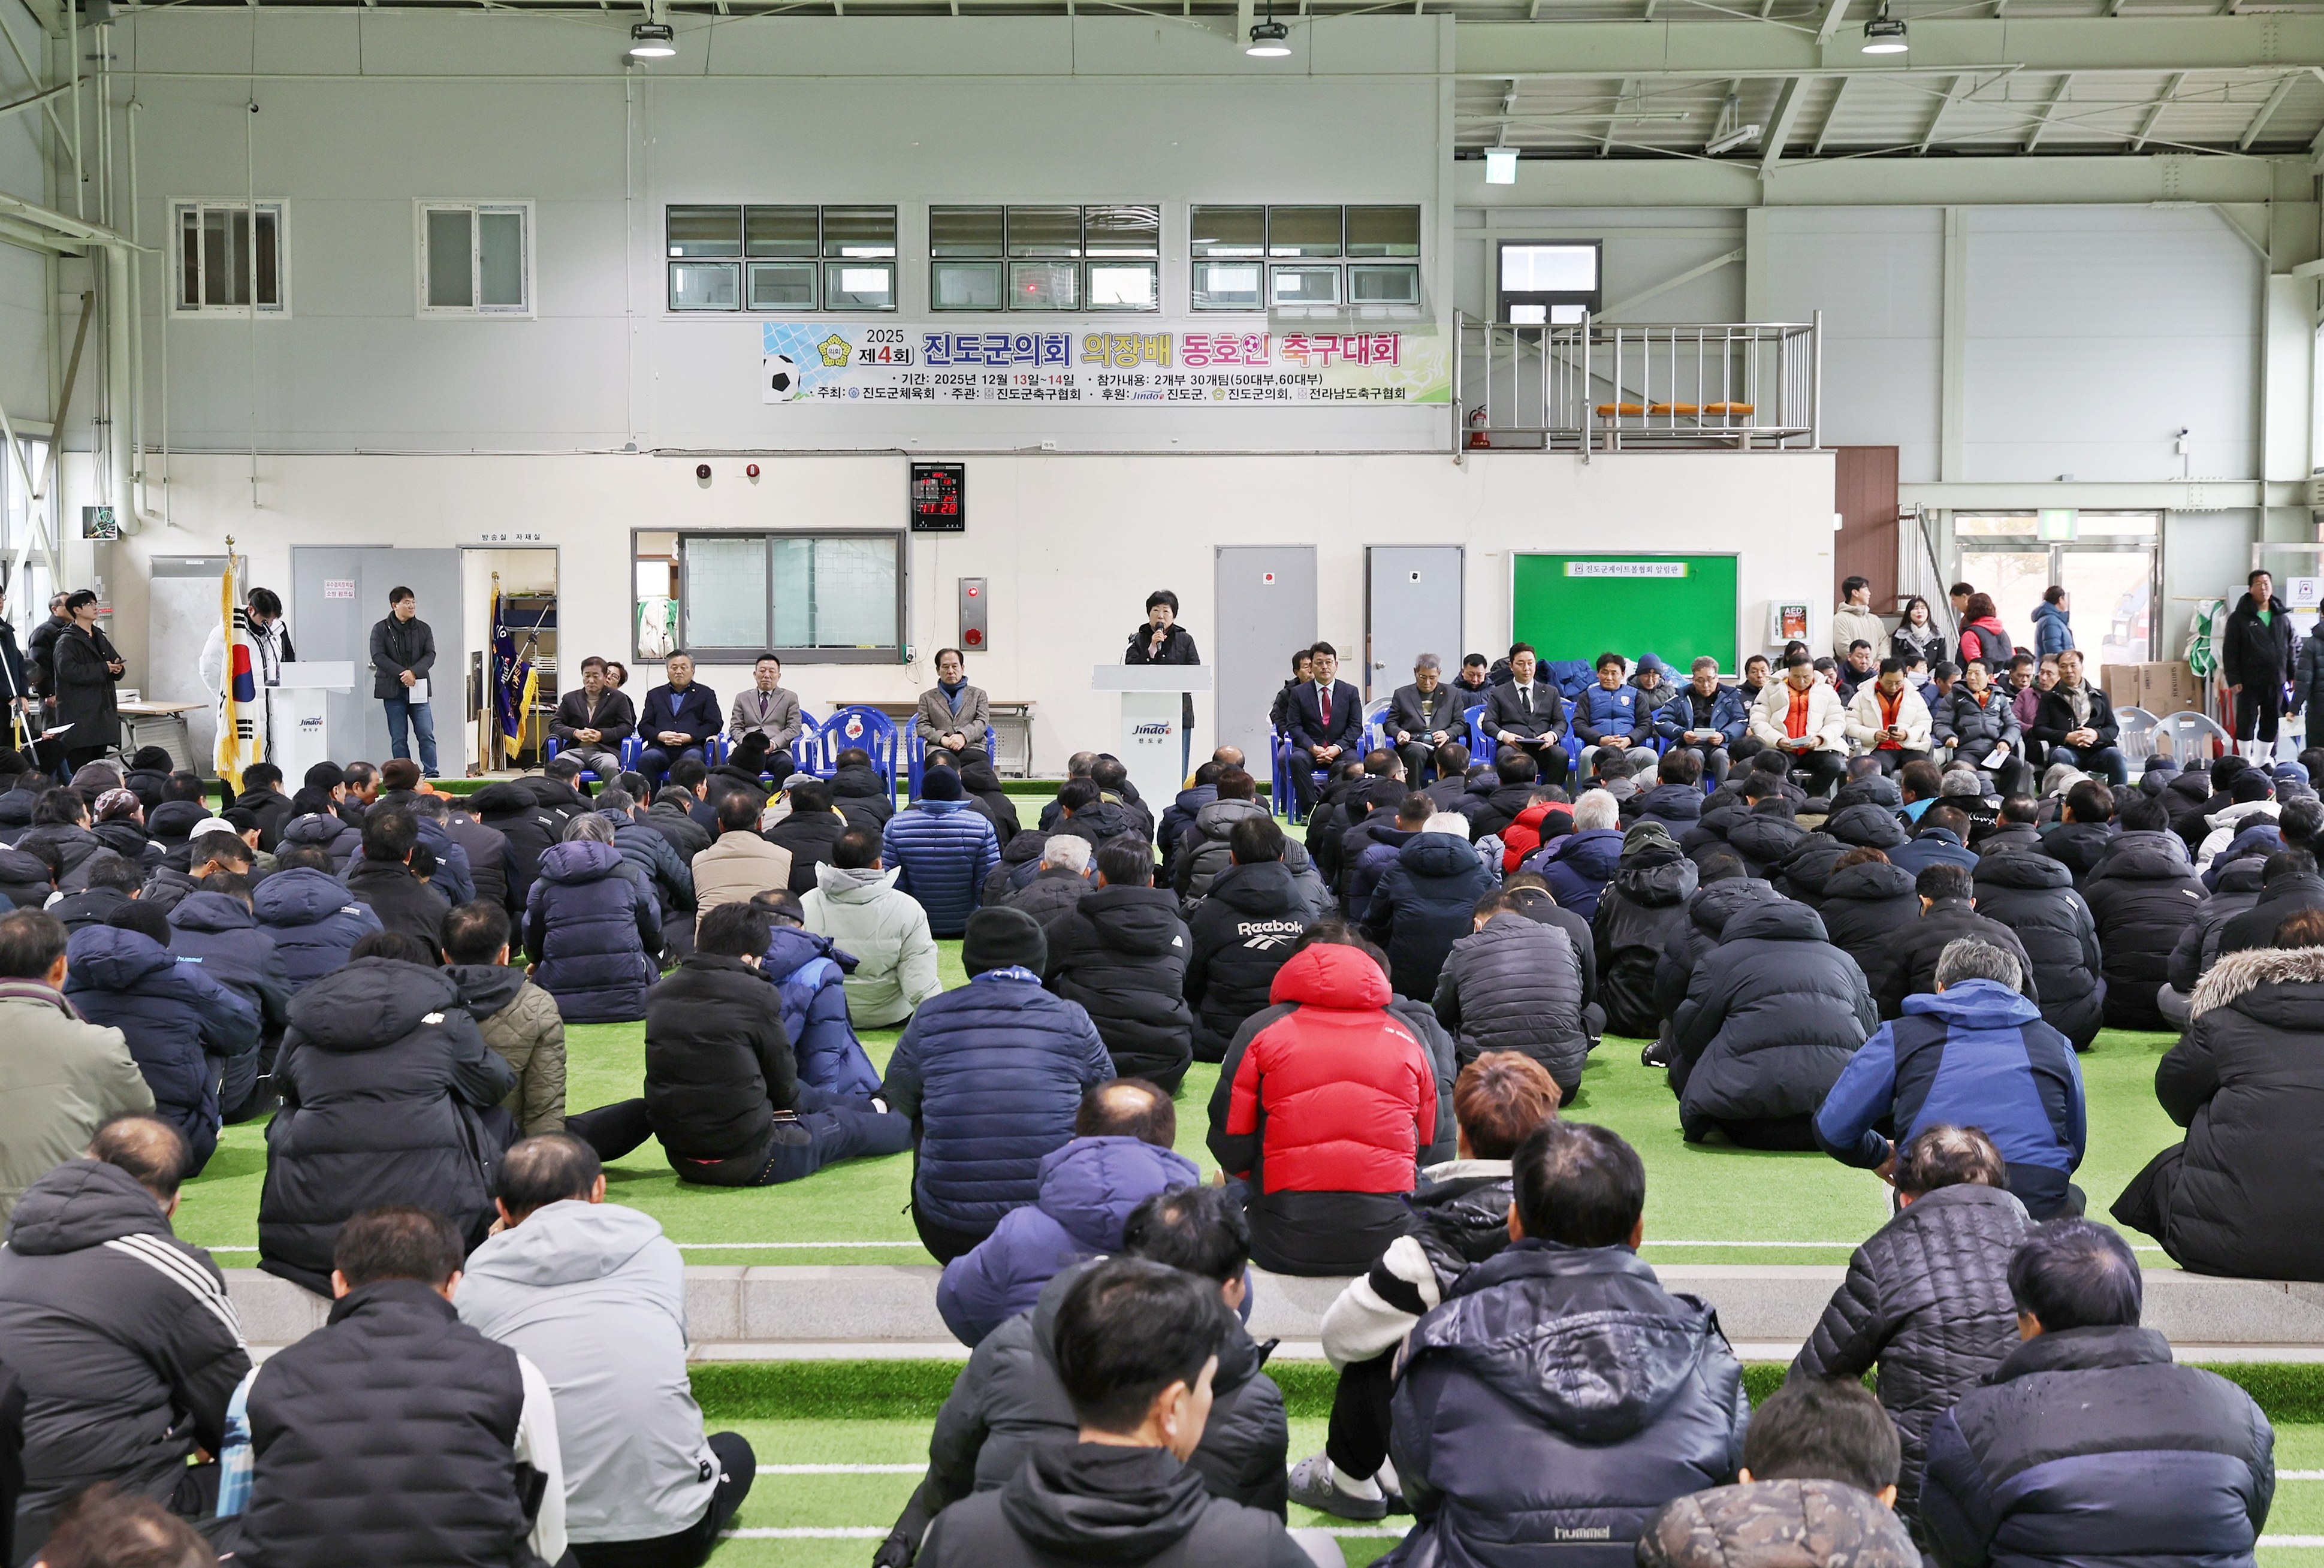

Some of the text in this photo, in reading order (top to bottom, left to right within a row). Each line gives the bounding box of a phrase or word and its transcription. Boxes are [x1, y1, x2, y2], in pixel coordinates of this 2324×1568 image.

[867, 330, 904, 343] 2025
[858, 346, 910, 364] 제4회
[922, 333, 1400, 367] 진도군의회 의장배 동호인 축구대회
[902, 373, 1075, 386] 기간: 2025년 12월 13일~14일
[1097, 373, 1323, 386] 참가내용: 2개부 30개팀(50대부,60대부)
[817, 386, 935, 400] 주최: 진도군체육회
[952, 388, 1080, 400] 주관: 진도군축구협회
[1101, 388, 1129, 400] 후원:
[1167, 388, 1207, 401] 진도군,
[1229, 388, 1292, 400] 진도군의회,
[1309, 387, 1406, 400] 전라남도축구협회
[941, 503, 956, 513] 28
[1586, 565, 1679, 575] 진도군게이트볼협회 알림판
[1784, 606, 1803, 615] AED
[1132, 724, 1166, 735] Jindo
[1237, 920, 1303, 935] Reebok
[1555, 1525, 1610, 1540] hummel
